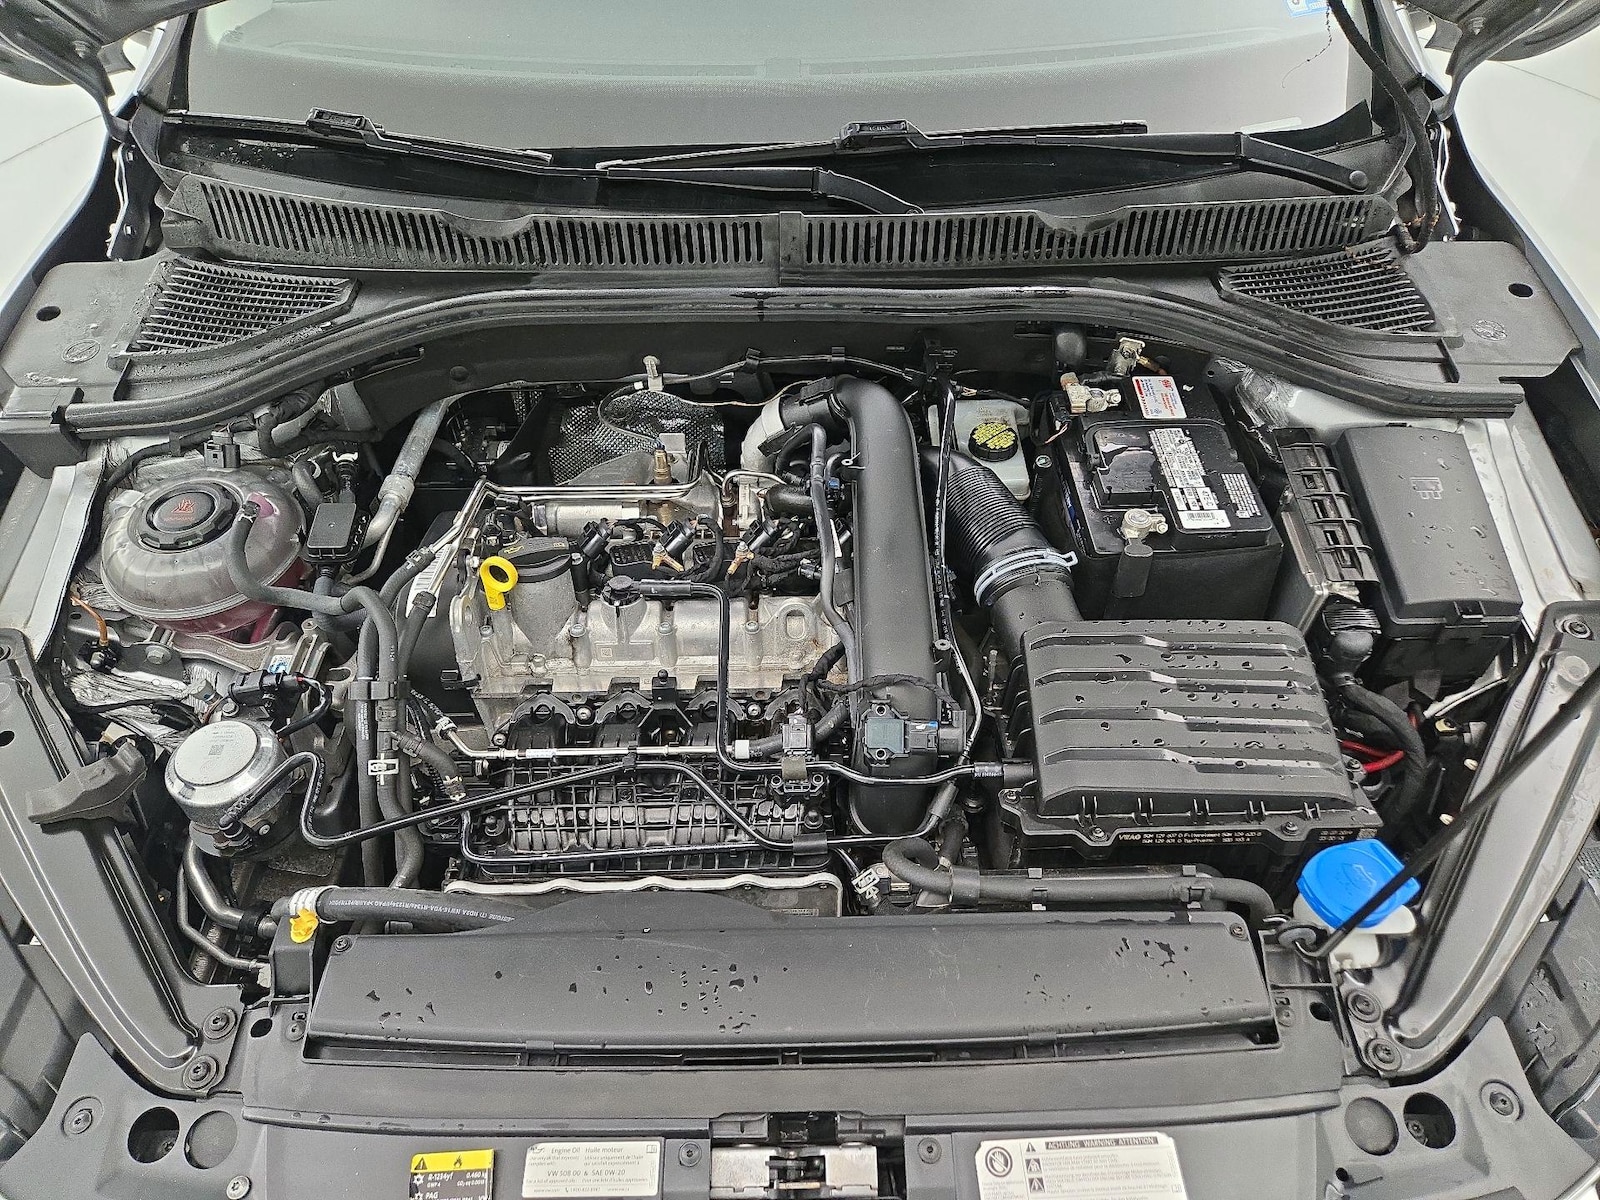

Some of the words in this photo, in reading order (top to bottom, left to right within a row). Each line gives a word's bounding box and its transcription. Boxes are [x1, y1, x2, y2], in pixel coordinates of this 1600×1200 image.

[1082, 1139, 1116, 1148] WARNING
[1118, 1136, 1154, 1146] ATTENTION
[551, 1146, 570, 1155] Engine
